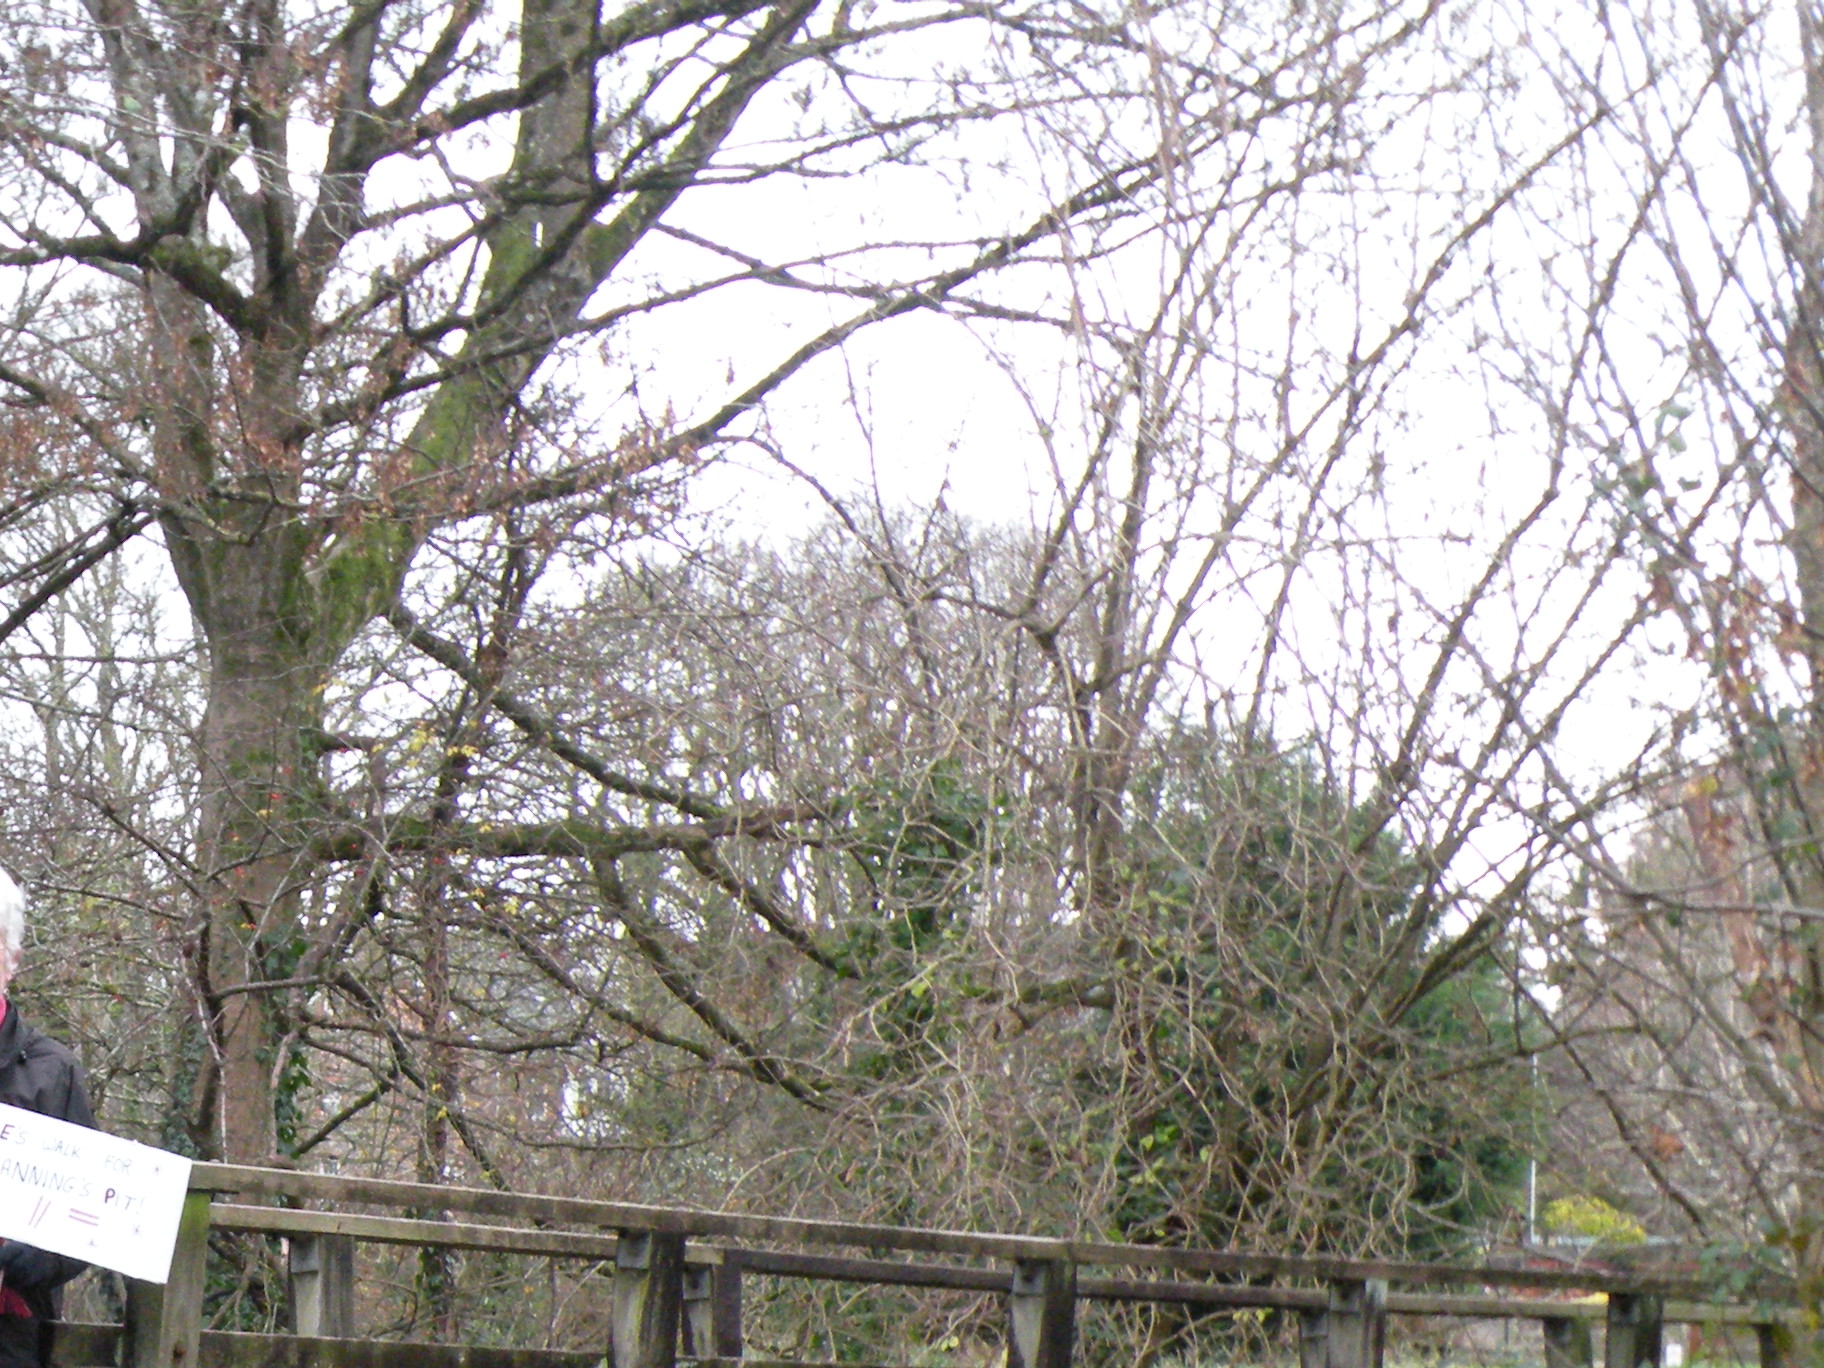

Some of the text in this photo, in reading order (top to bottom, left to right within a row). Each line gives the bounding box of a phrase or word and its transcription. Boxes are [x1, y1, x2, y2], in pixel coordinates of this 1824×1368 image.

[41, 1137, 82, 1160] WALK
[103, 1154, 133, 1176] FOR
[103, 1187, 146, 1215] PIT!
